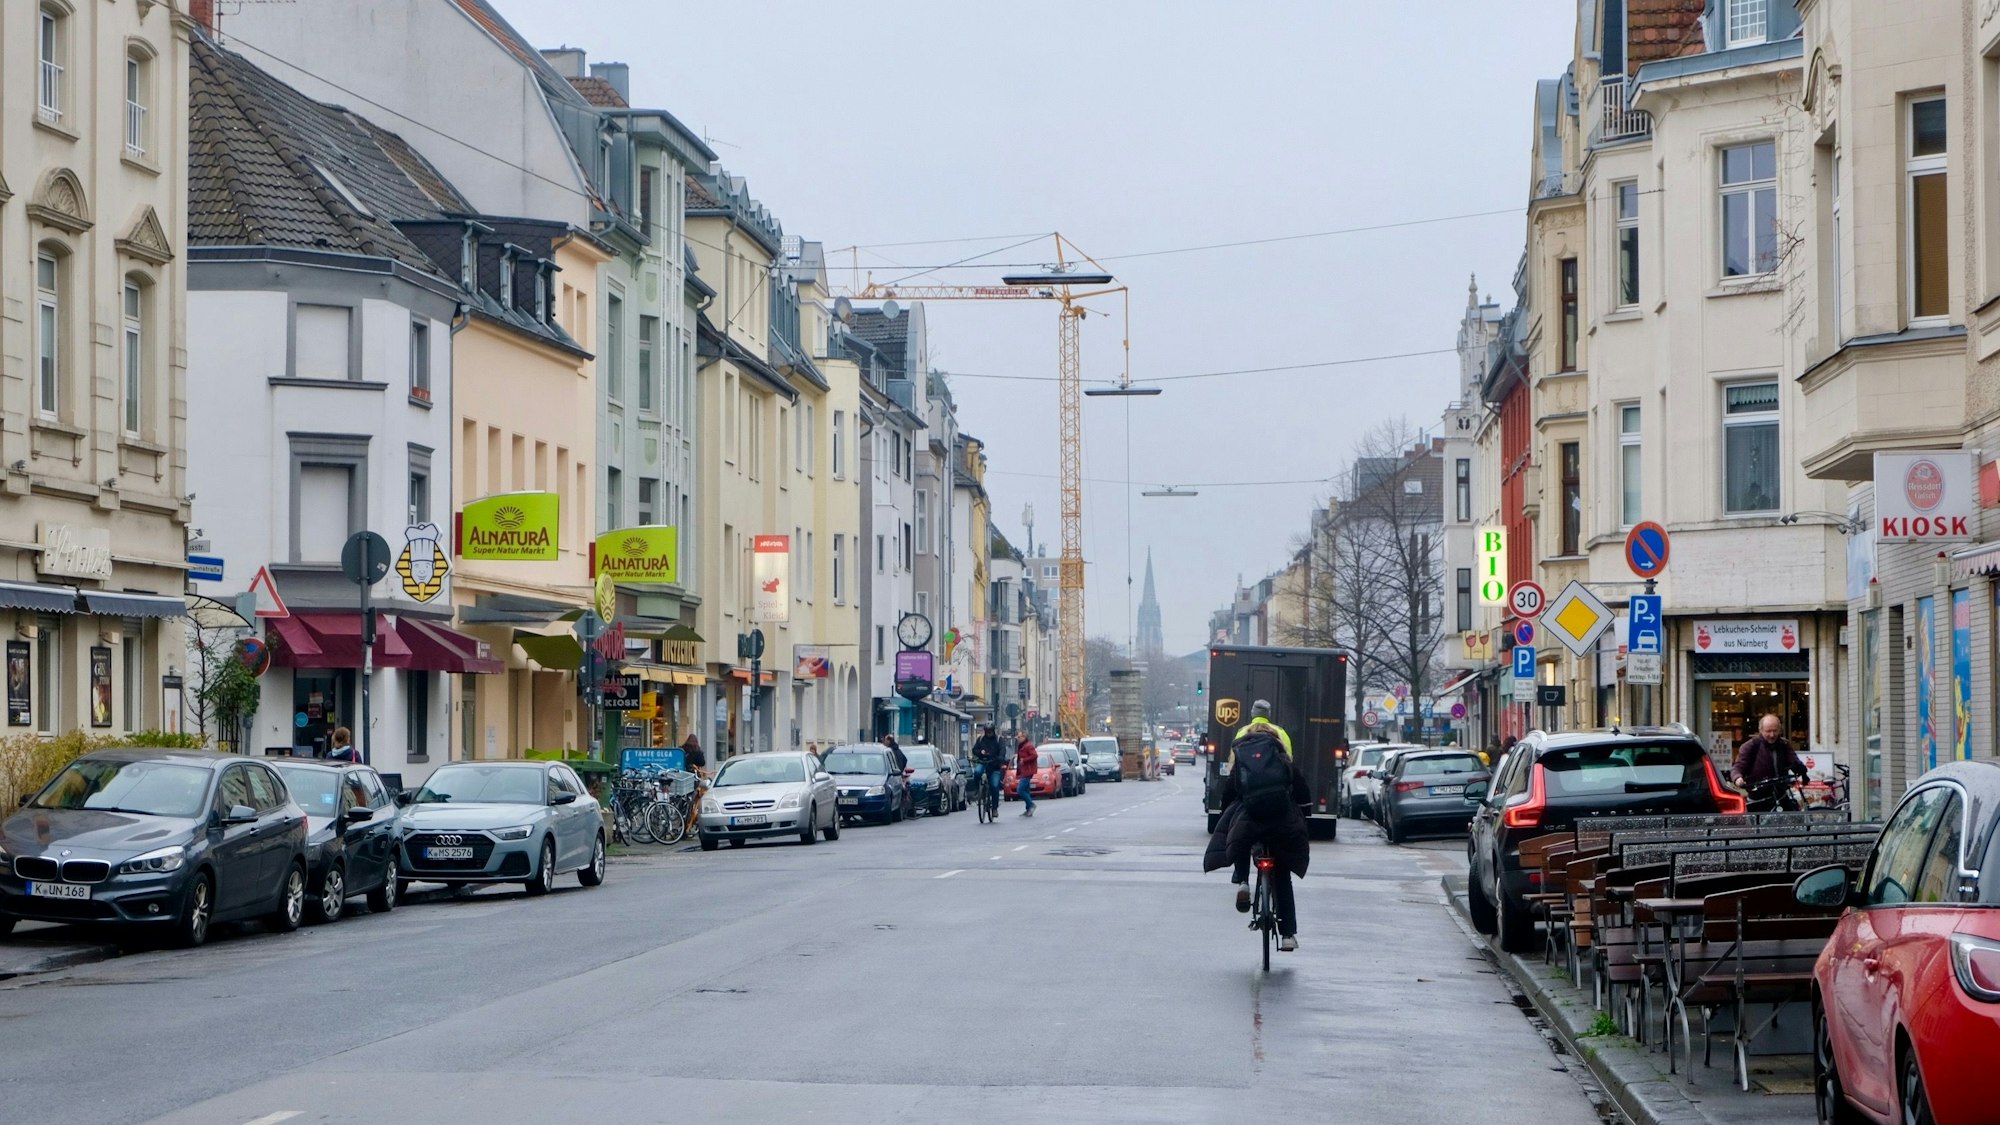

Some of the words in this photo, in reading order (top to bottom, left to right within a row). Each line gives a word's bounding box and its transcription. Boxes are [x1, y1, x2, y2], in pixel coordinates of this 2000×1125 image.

[1882, 516, 1968, 537] KIOSK
[469, 526, 550, 546] ALNATURA
[473, 546, 496, 556] Super
[520, 547, 545, 555] Markt
[601, 554, 670, 571] ALNATURA
[1483, 532, 1504, 601] BIO
[758, 600, 778, 610] Spiel
[1516, 591, 1538, 608] 30
[763, 611, 784, 620] Kleid
[1634, 599, 1648, 623] P
[1713, 624, 1777, 634] Lebkuchen-Schmidt
[1737, 638, 1769, 649] Nürnberg
[1518, 650, 1531, 673] P
[605, 699, 639, 707] KIOSK
[1217, 707, 1238, 722] ups
[438, 849, 450, 857] MS
[451, 849, 472, 857] 2576
[35, 884, 42, 894] K
[49, 885, 63, 896] UN
[65, 886, 85, 897] 168
